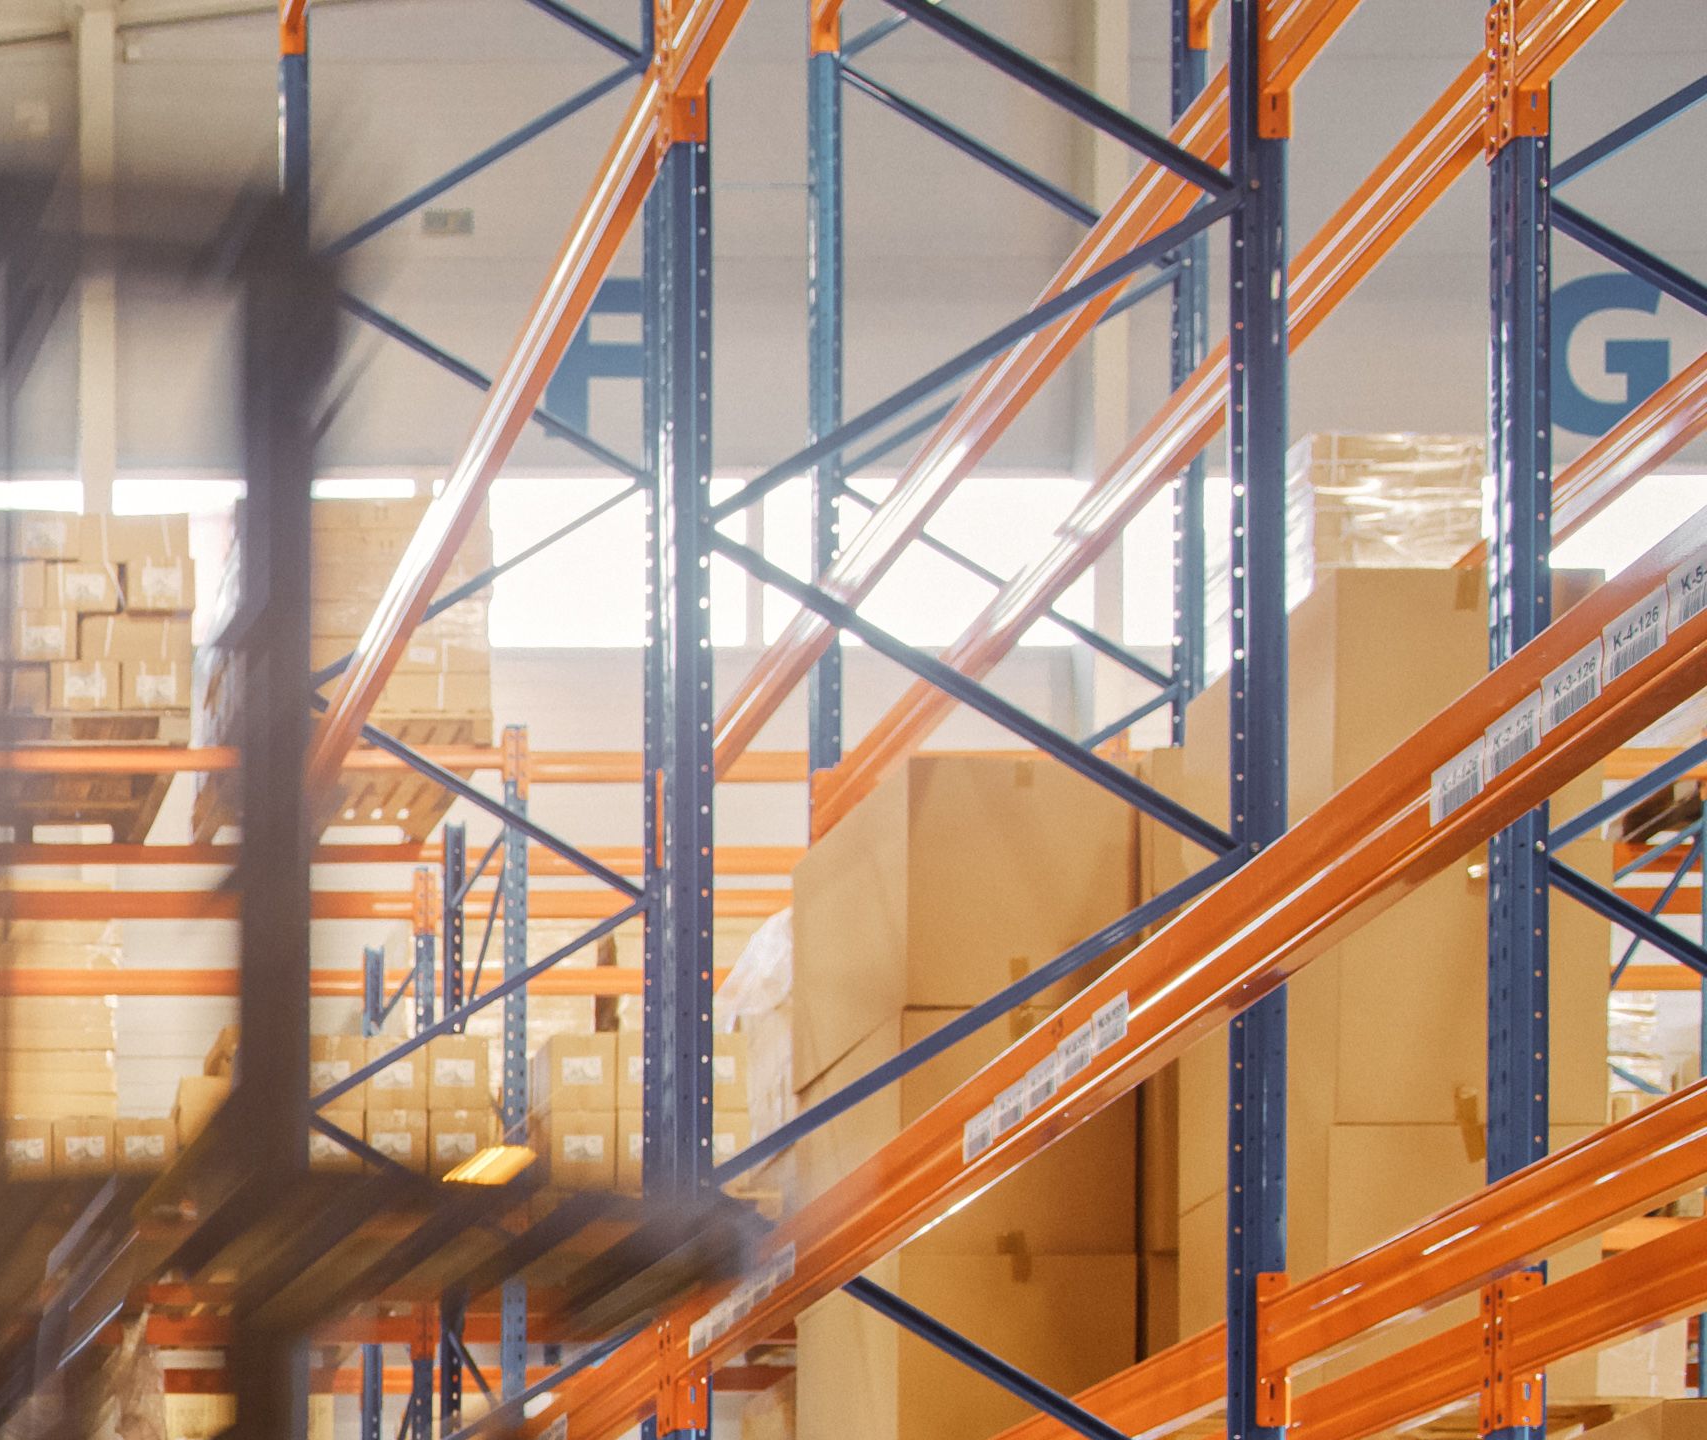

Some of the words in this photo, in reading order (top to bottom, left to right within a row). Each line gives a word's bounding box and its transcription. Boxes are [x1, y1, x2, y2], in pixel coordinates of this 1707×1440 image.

[1551, 272, 1671, 437] G
[1612, 605, 1659, 649] K-4-126
[1553, 655, 1597, 698] K-3-126
